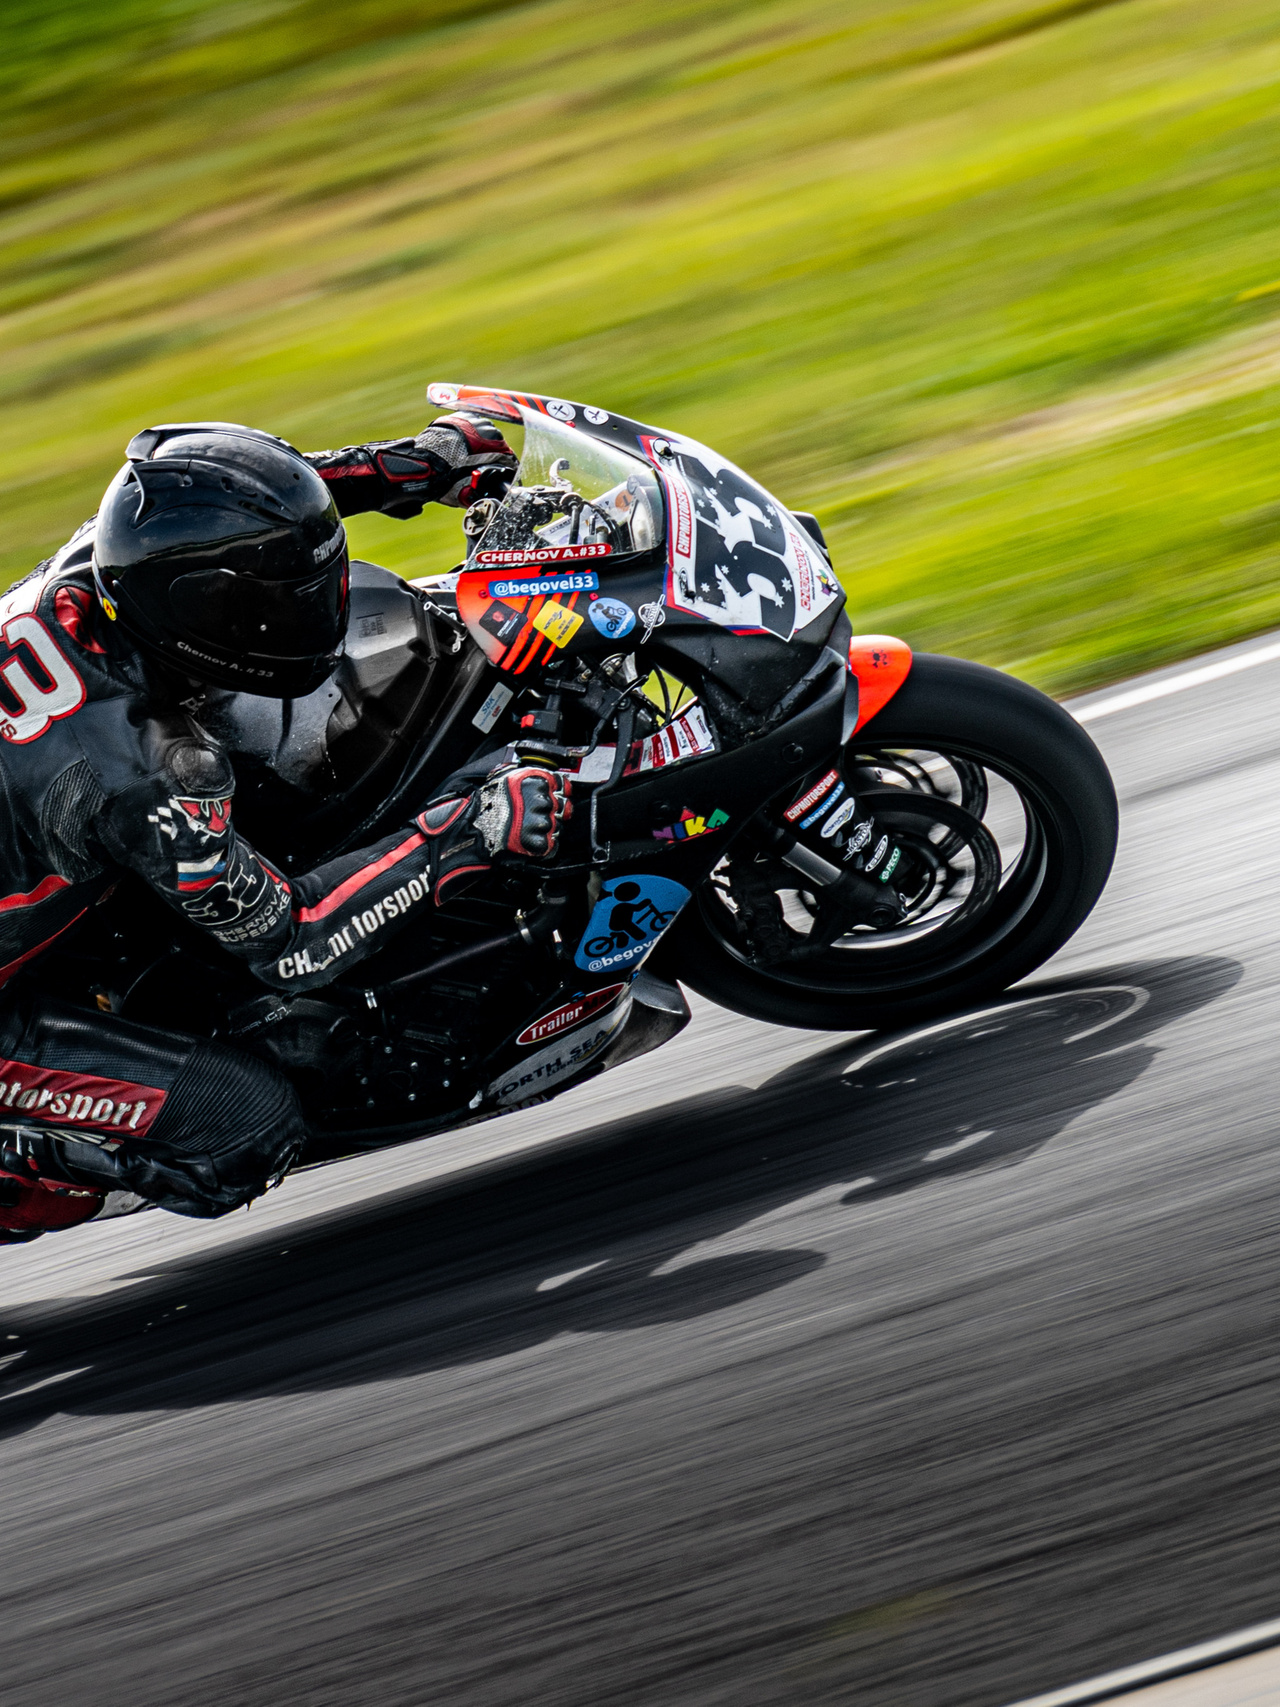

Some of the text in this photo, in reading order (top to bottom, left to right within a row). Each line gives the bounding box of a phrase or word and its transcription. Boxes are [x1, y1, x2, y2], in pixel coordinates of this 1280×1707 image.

[481, 545, 606, 563] CHERNOV A.#33
[494, 575, 594, 596] @begovel33
[177, 641, 227, 666] Chernov
[257, 669, 274, 678] 33
[482, 696, 495, 714] SBK
[787, 771, 837, 820] CHPMOTORSPORT
[803, 784, 843, 827] @begovel33
[887, 848, 900, 872] PECO
[570, 1029, 608, 1058] SEA
